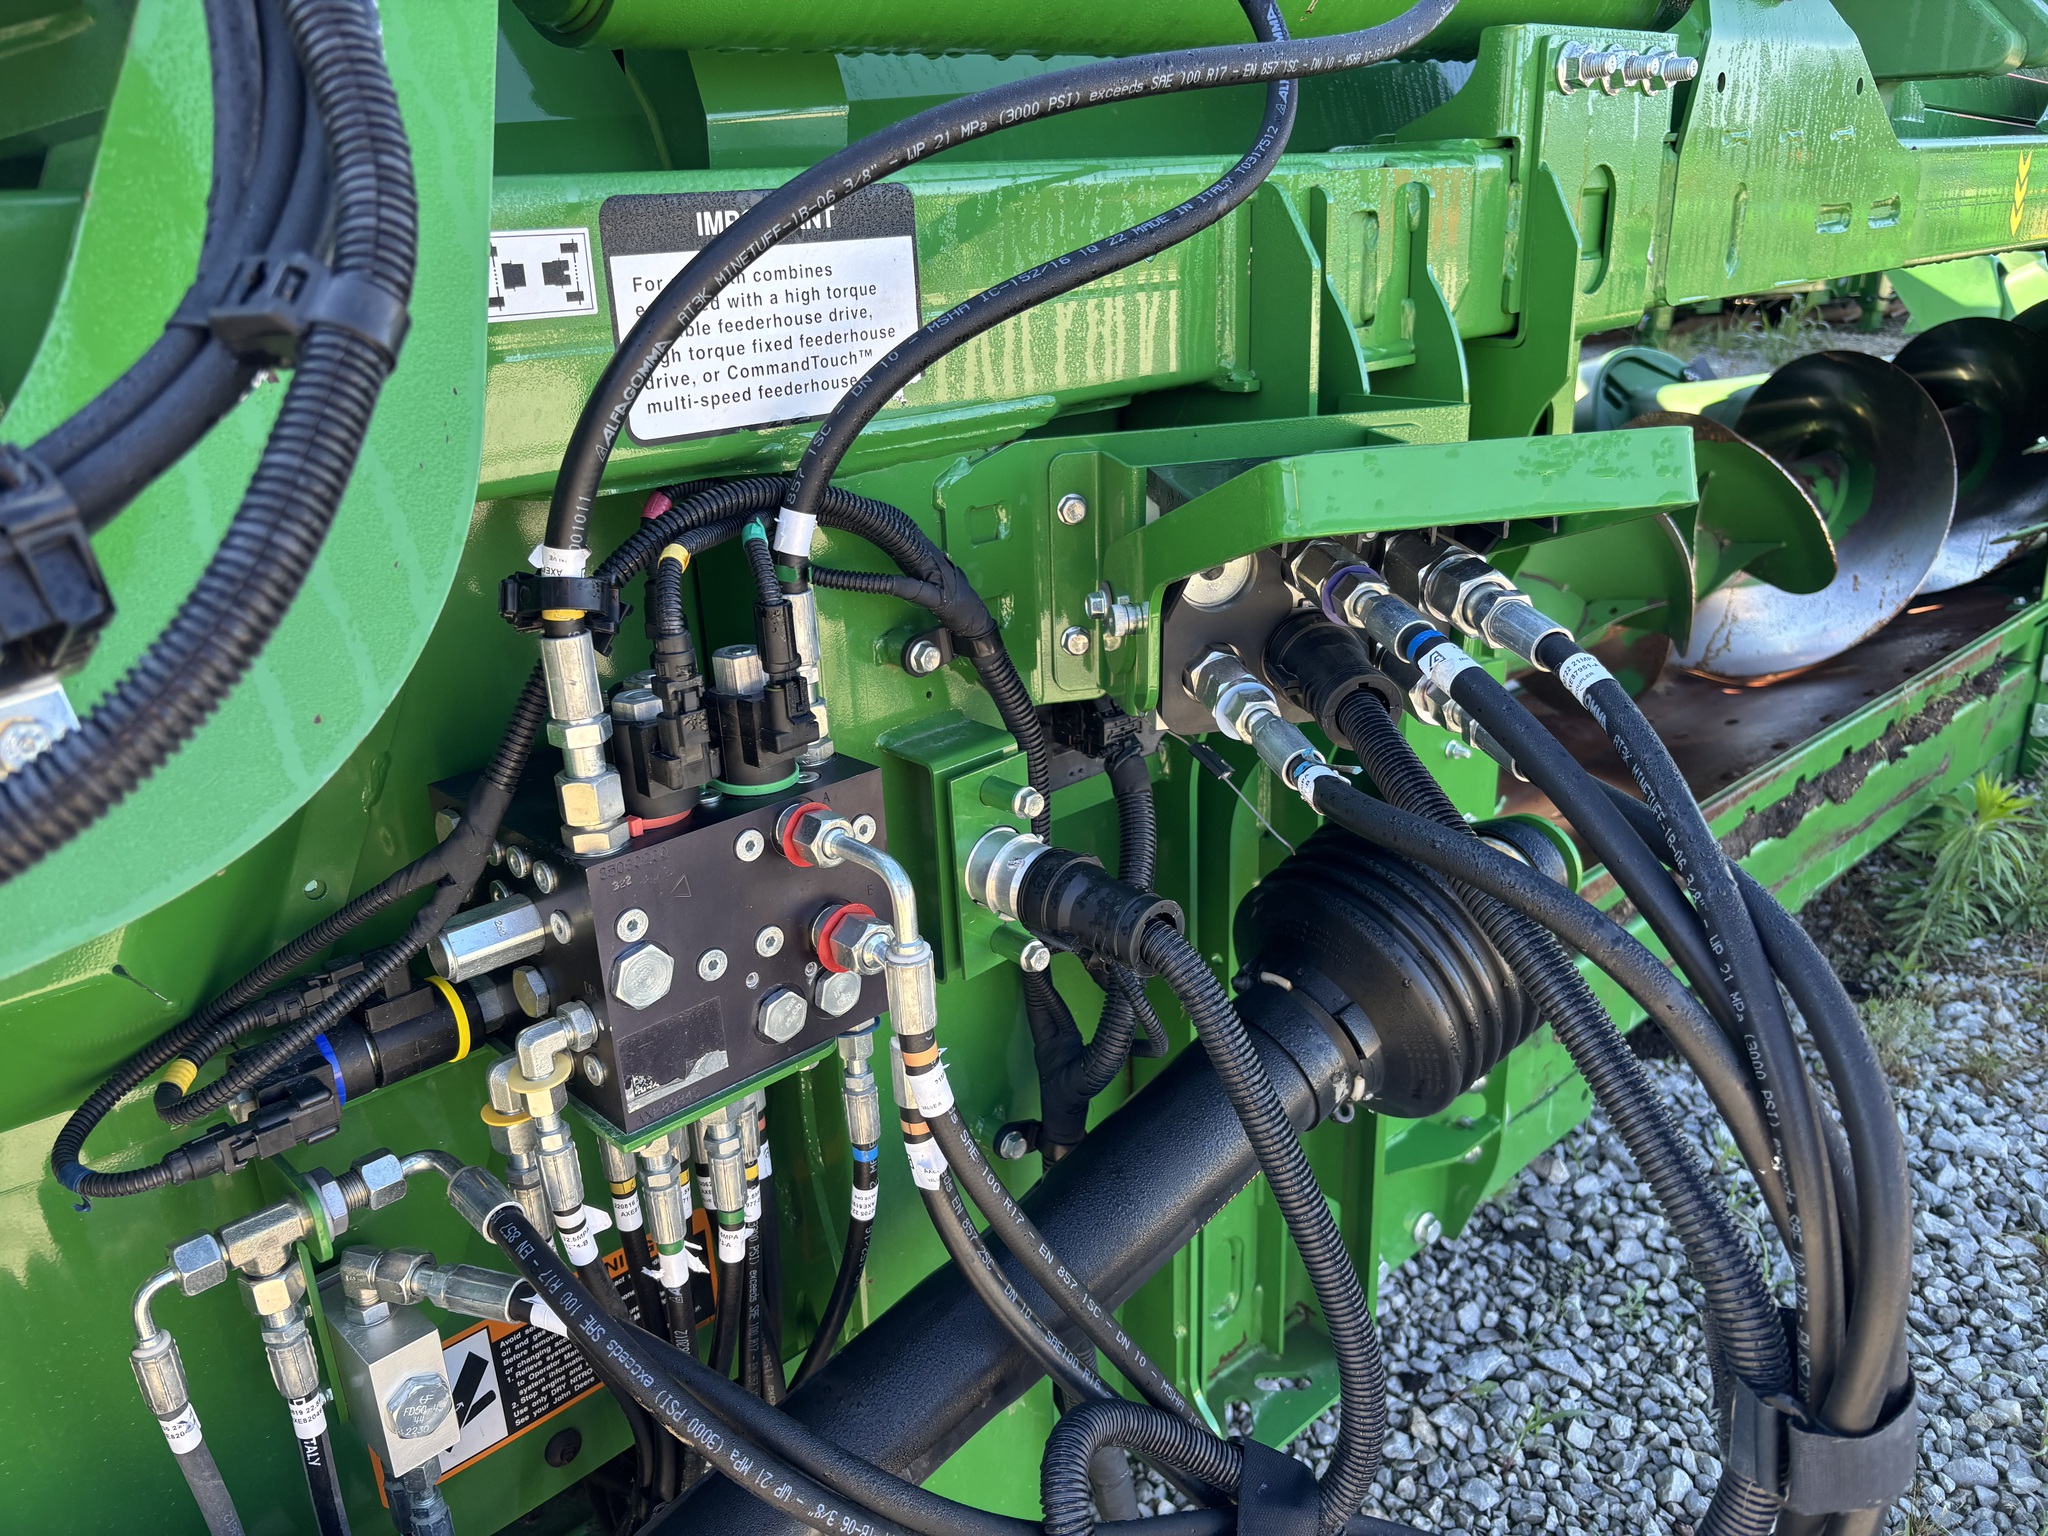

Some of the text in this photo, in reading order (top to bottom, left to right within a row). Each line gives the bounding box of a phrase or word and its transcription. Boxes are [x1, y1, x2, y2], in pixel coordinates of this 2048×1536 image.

[696, 205, 835, 237] IMPNT
[603, 340, 674, 448] ALFAGOMMA
[677, 287, 712, 327] AT3K
[906, 143, 926, 162] WP
[934, 130, 951, 150] 21
[961, 120, 988, 139] MPa
[999, 101, 1040, 126] (3000
[1048, 91, 1081, 113] PSI)
[1089, 79, 1144, 102] exceeds
[1150, 73, 1175, 91] SAE
[1181, 70, 1201, 86] 100
[1205, 66, 1228, 82] R17
[1243, 63, 1258, 77] EN
[1261, 61, 1279, 76] 857
[632, 276, 663, 292] For
[753, 263, 833, 283] combines
[727, 290, 763, 309] with
[770, 293, 778, 305] a
[785, 287, 820, 306] high
[826, 284, 877, 300] torque
[718, 311, 823, 334] feederhouse
[828, 306, 873, 322] drive,
[689, 343, 746, 362] torque
[752, 335, 793, 354] fixed
[800, 326, 896, 348] feederhouse
[787, 467, 805, 504] 857
[808, 423, 832, 456] 1SC
[851, 375, 873, 397] DN
[880, 351, 899, 369] 10
[926, 303, 971, 333] MSHA
[1106, 233, 1127, 246] 22
[1131, 214, 1170, 236] MADE
[1176, 202, 1194, 216] IN
[1197, 176, 1235, 204] ITALY
[645, 373, 696, 391] drive,
[703, 370, 720, 383] or
[647, 376, 858, 414] multi-speed feederhouse
[498, 1222, 522, 1244] 857
[515, 1240, 535, 1260] EN
[951, 1195, 965, 1216] EN
[961, 1217, 979, 1242] 857
[1004, 1283, 1018, 1303] DN
[1019, 1302, 1032, 1319] 10
[538, 1269, 564, 1295] R17
[960, 1129, 981, 1162] SAE
[981, 1166, 1001, 1194] 100
[1003, 1197, 1025, 1224] R17
[1039, 1242, 1054, 1265] EN
[1056, 1266, 1078, 1290] 857
[1082, 1294, 1102, 1318] 1SC
[1116, 1330, 1130, 1350] DN
[1133, 1351, 1147, 1367] 10
[1160, 1379, 1186, 1412] MSHA
[559, 1292, 582, 1317] 100
[500, 1332, 521, 1348] Avoid
[579, 1314, 606, 1342] SAE
[501, 1330, 546, 1357] oil and gas
[503, 1349, 528, 1366] Before
[505, 1366, 513, 1375] or
[517, 1346, 551, 1369] changing
[515, 1360, 543, 1379] Relieve
[545, 1343, 572, 1362] system
[516, 1379, 525, 1387] to
[528, 1358, 560, 1381] Operator
[606, 1339, 655, 1388] exceeds
[519, 1377, 545, 1396] system
[520, 1391, 538, 1404] Stop
[541, 1374, 566, 1392] engine
[569, 1364, 583, 1376] and
[513, 1406, 528, 1418] Use
[531, 1395, 547, 1408] only
[551, 1383, 566, 1396] DRY
[515, 1376, 595, 1427] See your John Deere
[655, 1390, 688, 1423] PSI)
[687, 1418, 724, 1453] (3000
[730, 1448, 754, 1476] MPa
[755, 1469, 774, 1489] 21
[774, 1484, 793, 1502] WP
